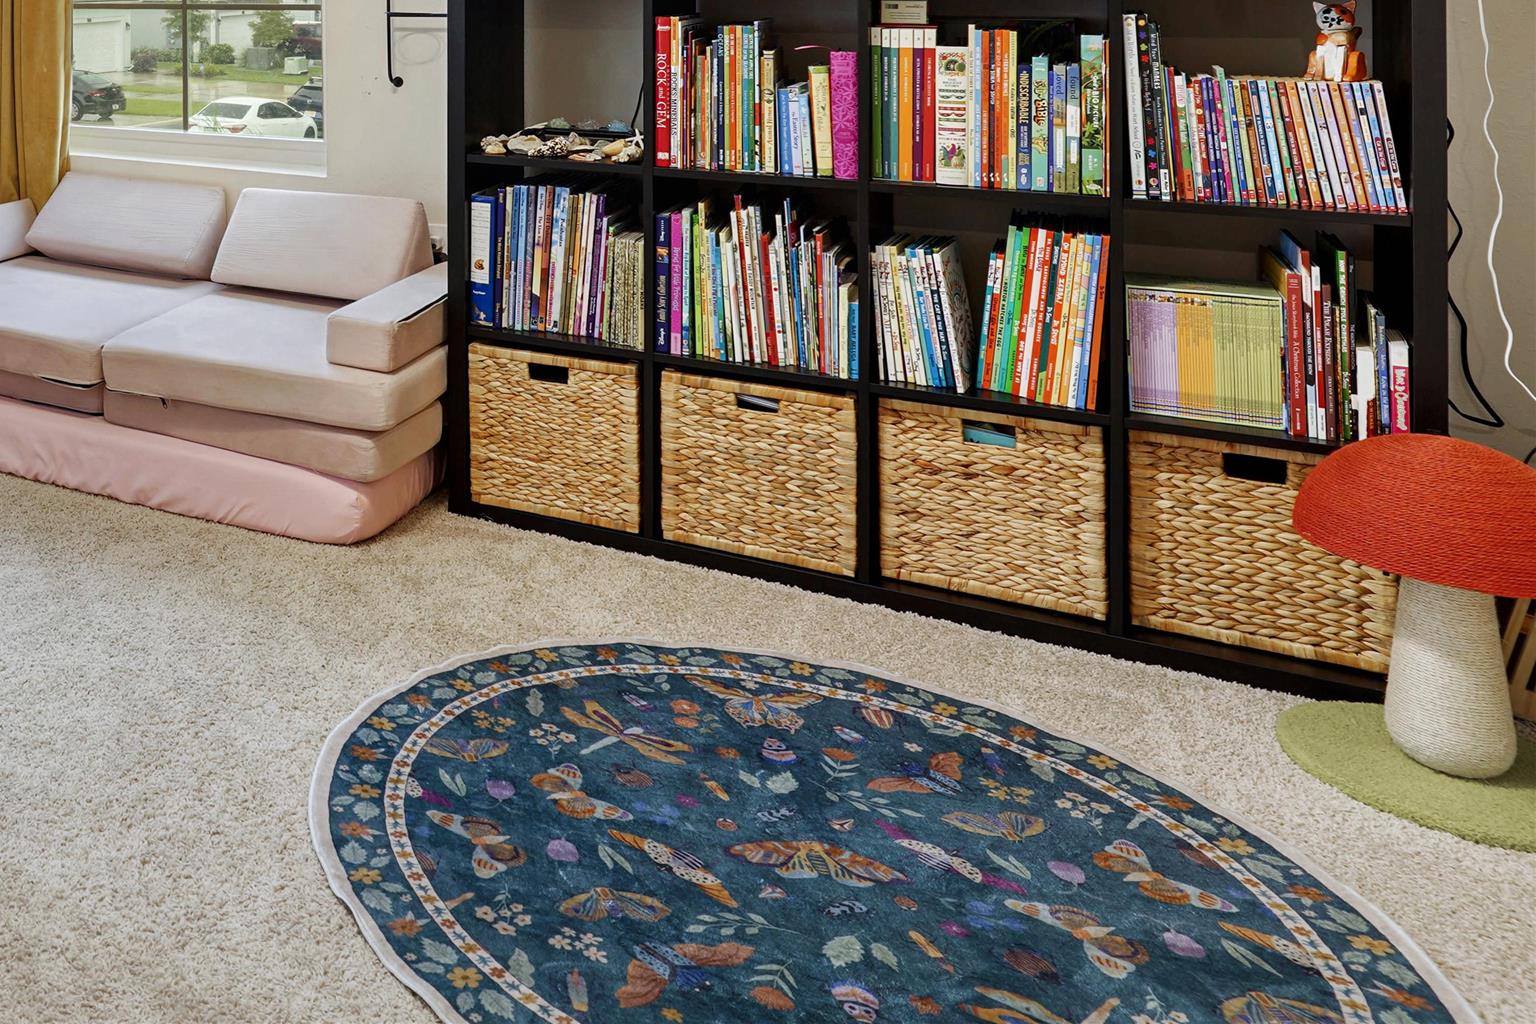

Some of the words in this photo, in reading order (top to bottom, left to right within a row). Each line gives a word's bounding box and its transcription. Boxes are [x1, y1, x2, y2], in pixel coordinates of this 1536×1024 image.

[656, 53, 667, 86] ROCK
[1152, 61, 1162, 90] MANNERS
[658, 86, 666, 98] and
[1056, 74, 1064, 95] loved
[1070, 76, 1078, 100] found
[1019, 73, 1030, 124] INDESCRIBABLE
[656, 101, 667, 128] GEM
[792, 135, 800, 149] Story
[1060, 242, 1068, 250] ON
[1058, 252, 1067, 276] BEYOND
[658, 275, 666, 295] Collection
[1040, 265, 1048, 299] BARTHOLOMEW
[1055, 278, 1065, 304] ZEBRA!
[658, 296, 667, 308] Story
[658, 309, 666, 322] Family
